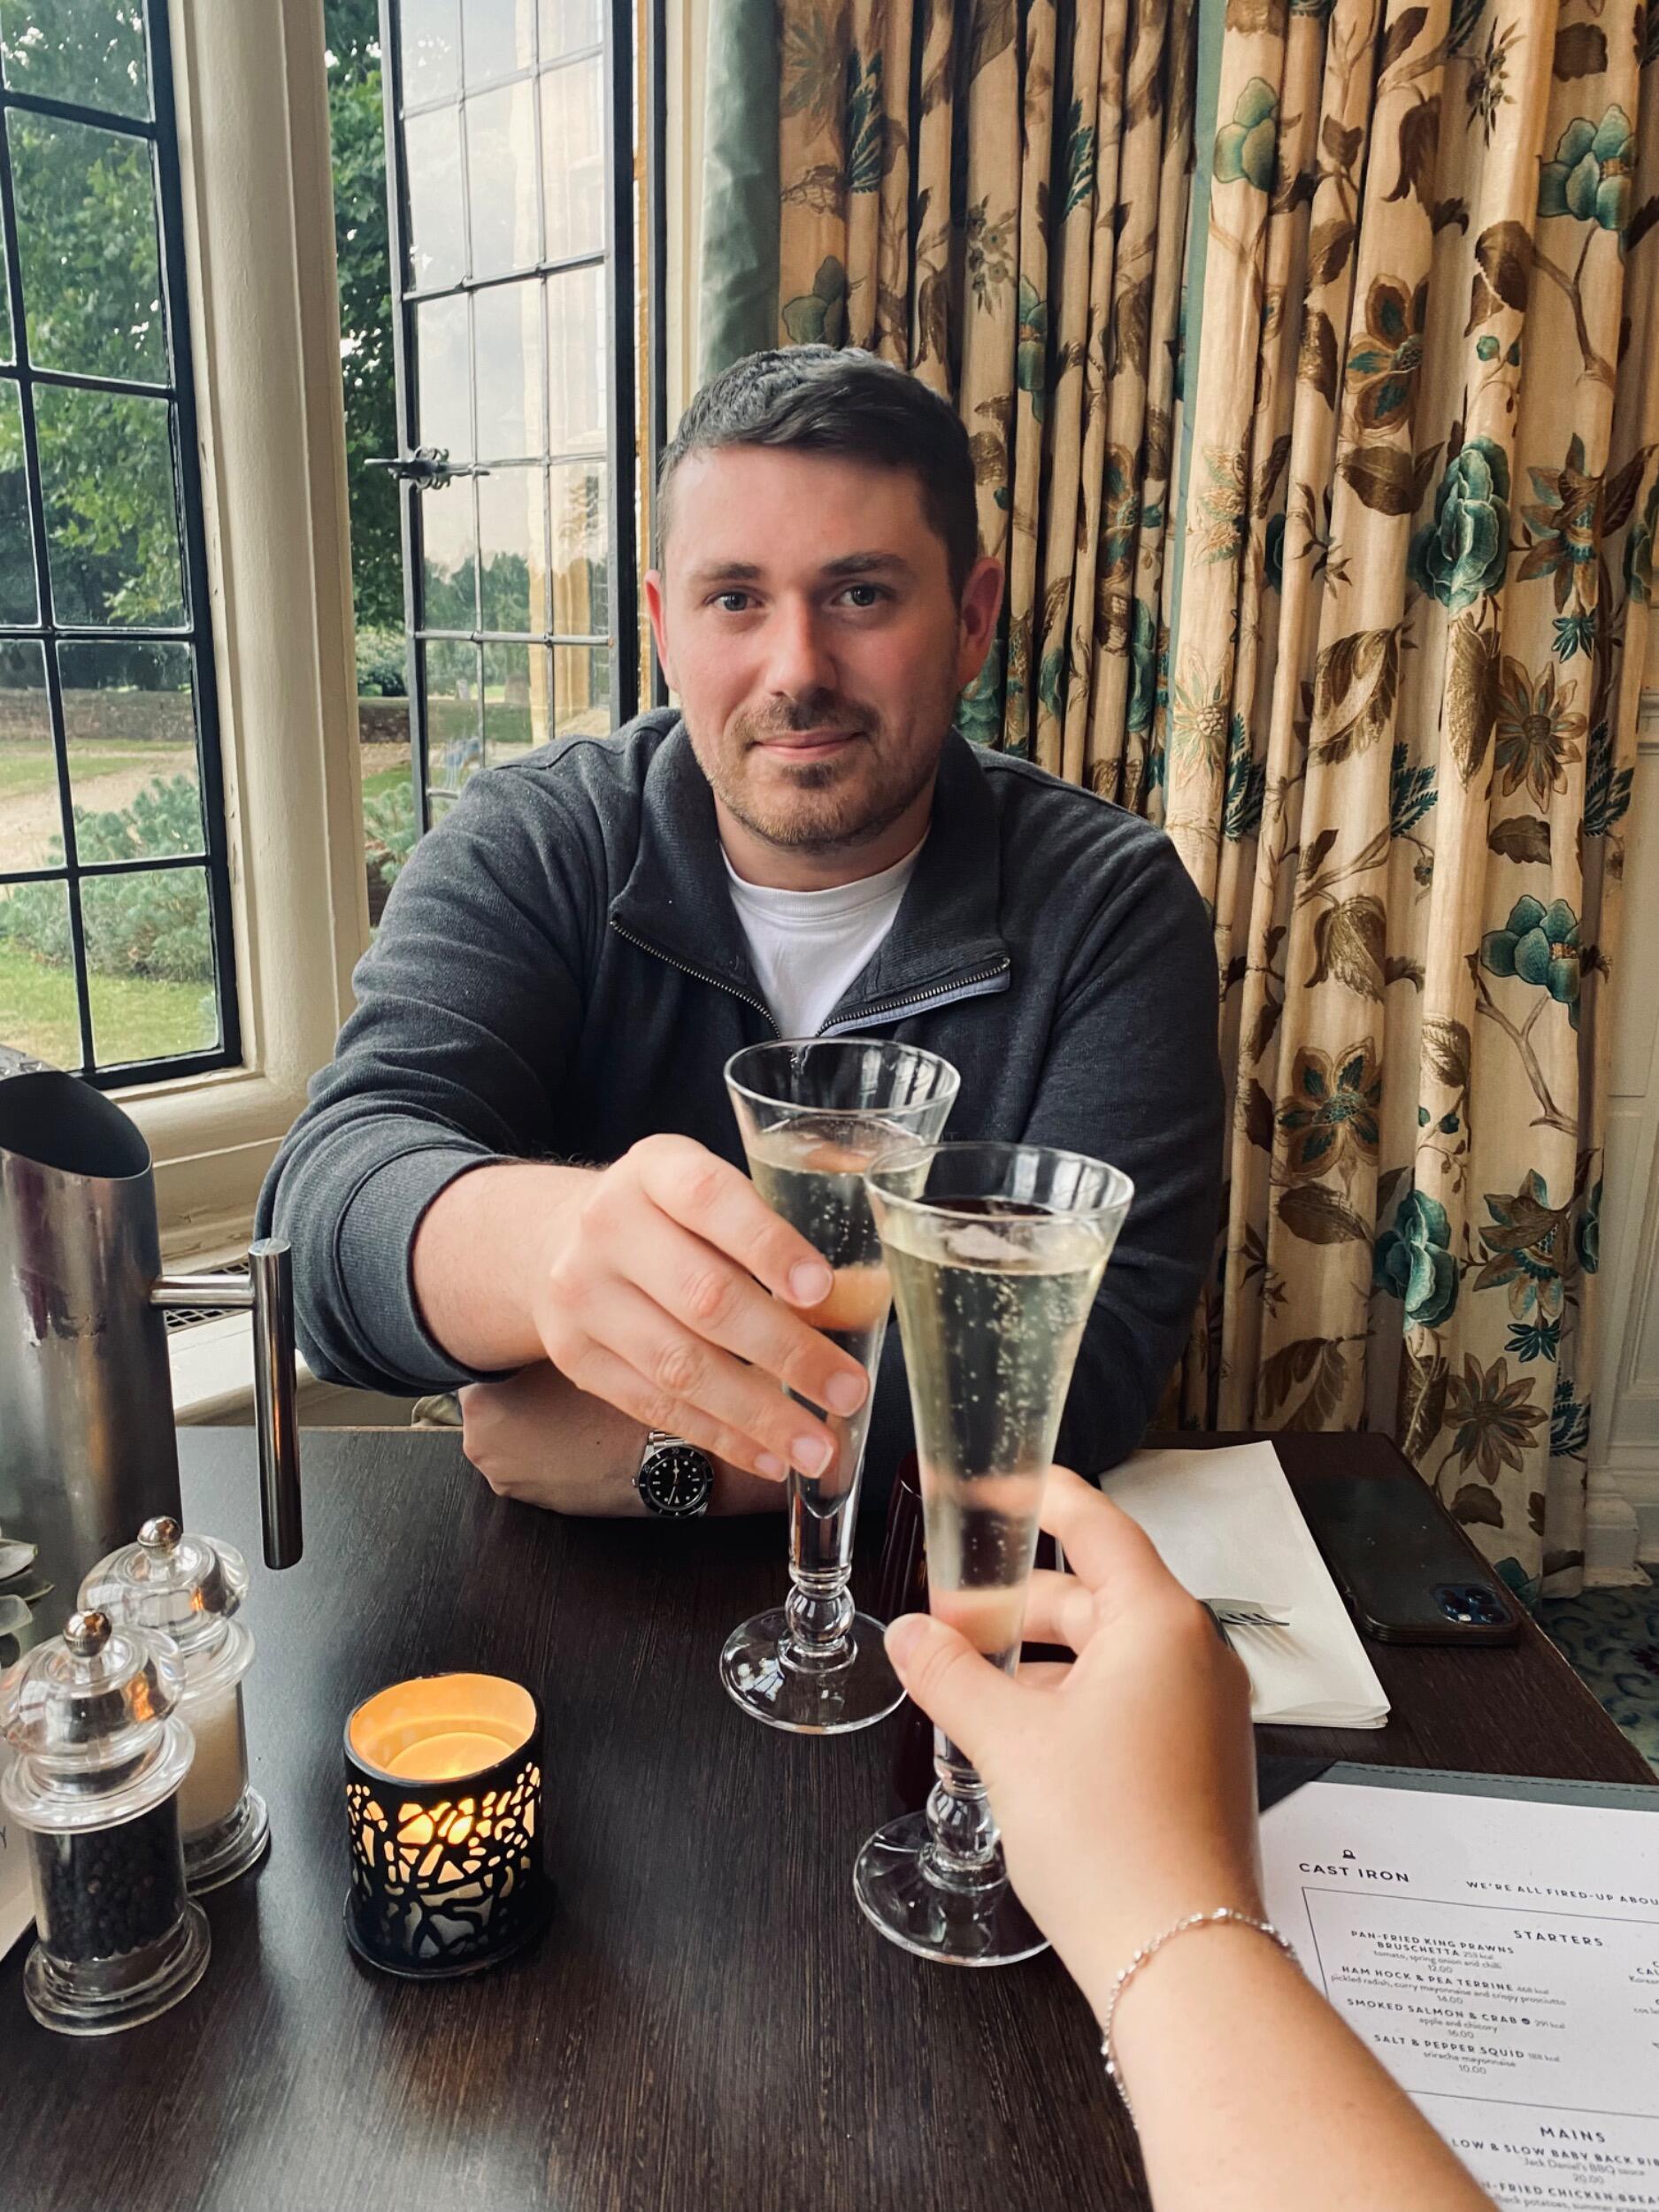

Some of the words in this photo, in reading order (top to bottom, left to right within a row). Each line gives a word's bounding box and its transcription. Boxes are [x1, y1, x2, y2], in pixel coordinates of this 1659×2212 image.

[1299, 1863, 1349, 1876] CAST
[1358, 1869, 1409, 1882] IRON
[1465, 1881, 1512, 1892] WE'RE
[1517, 1886, 1542, 1894] ALL
[1547, 1888, 1614, 1901] FIRED-UP
[1351, 1930, 1419, 1944] PAN-FRIED
[1425, 1938, 1455, 1947] KING
[1460, 1941, 1514, 1955] PRAWNS
[1513, 1930, 1603, 1947] STARTERS
[1377, 1941, 1459, 1956] BRUSCHETTA
[1341, 1966, 1371, 1976] HAM
[1375, 1970, 1411, 1980] HOCK
[1429, 1976, 1453, 1985] PEA
[1456, 1978, 1514, 1992] TERRINE
[1474, 1989, 1490, 1998] and
[1347, 1998, 1403, 2011] SMOKED
[1408, 2005, 1464, 2018] SALMON
[1481, 2014, 1517, 2024] CRAB
[1374, 2034, 1405, 2045] SALT
[1425, 2040, 1475, 2053] PEPPER
[1480, 2047, 1525, 2058] SQUID
[1458, 2064, 1487, 2074] 10.00
[1540, 2126, 1605, 2142] MAINS
[1452, 2138, 1484, 2149] LOW
[1504, 2144, 1545, 2155] SLOW
[1551, 2149, 1587, 2160] BABY
[1594, 2154, 1633, 2164] BACK
[1548, 2188, 1613, 2200] CHICKEN
[1618, 2193, 1659, 2205] BREA
